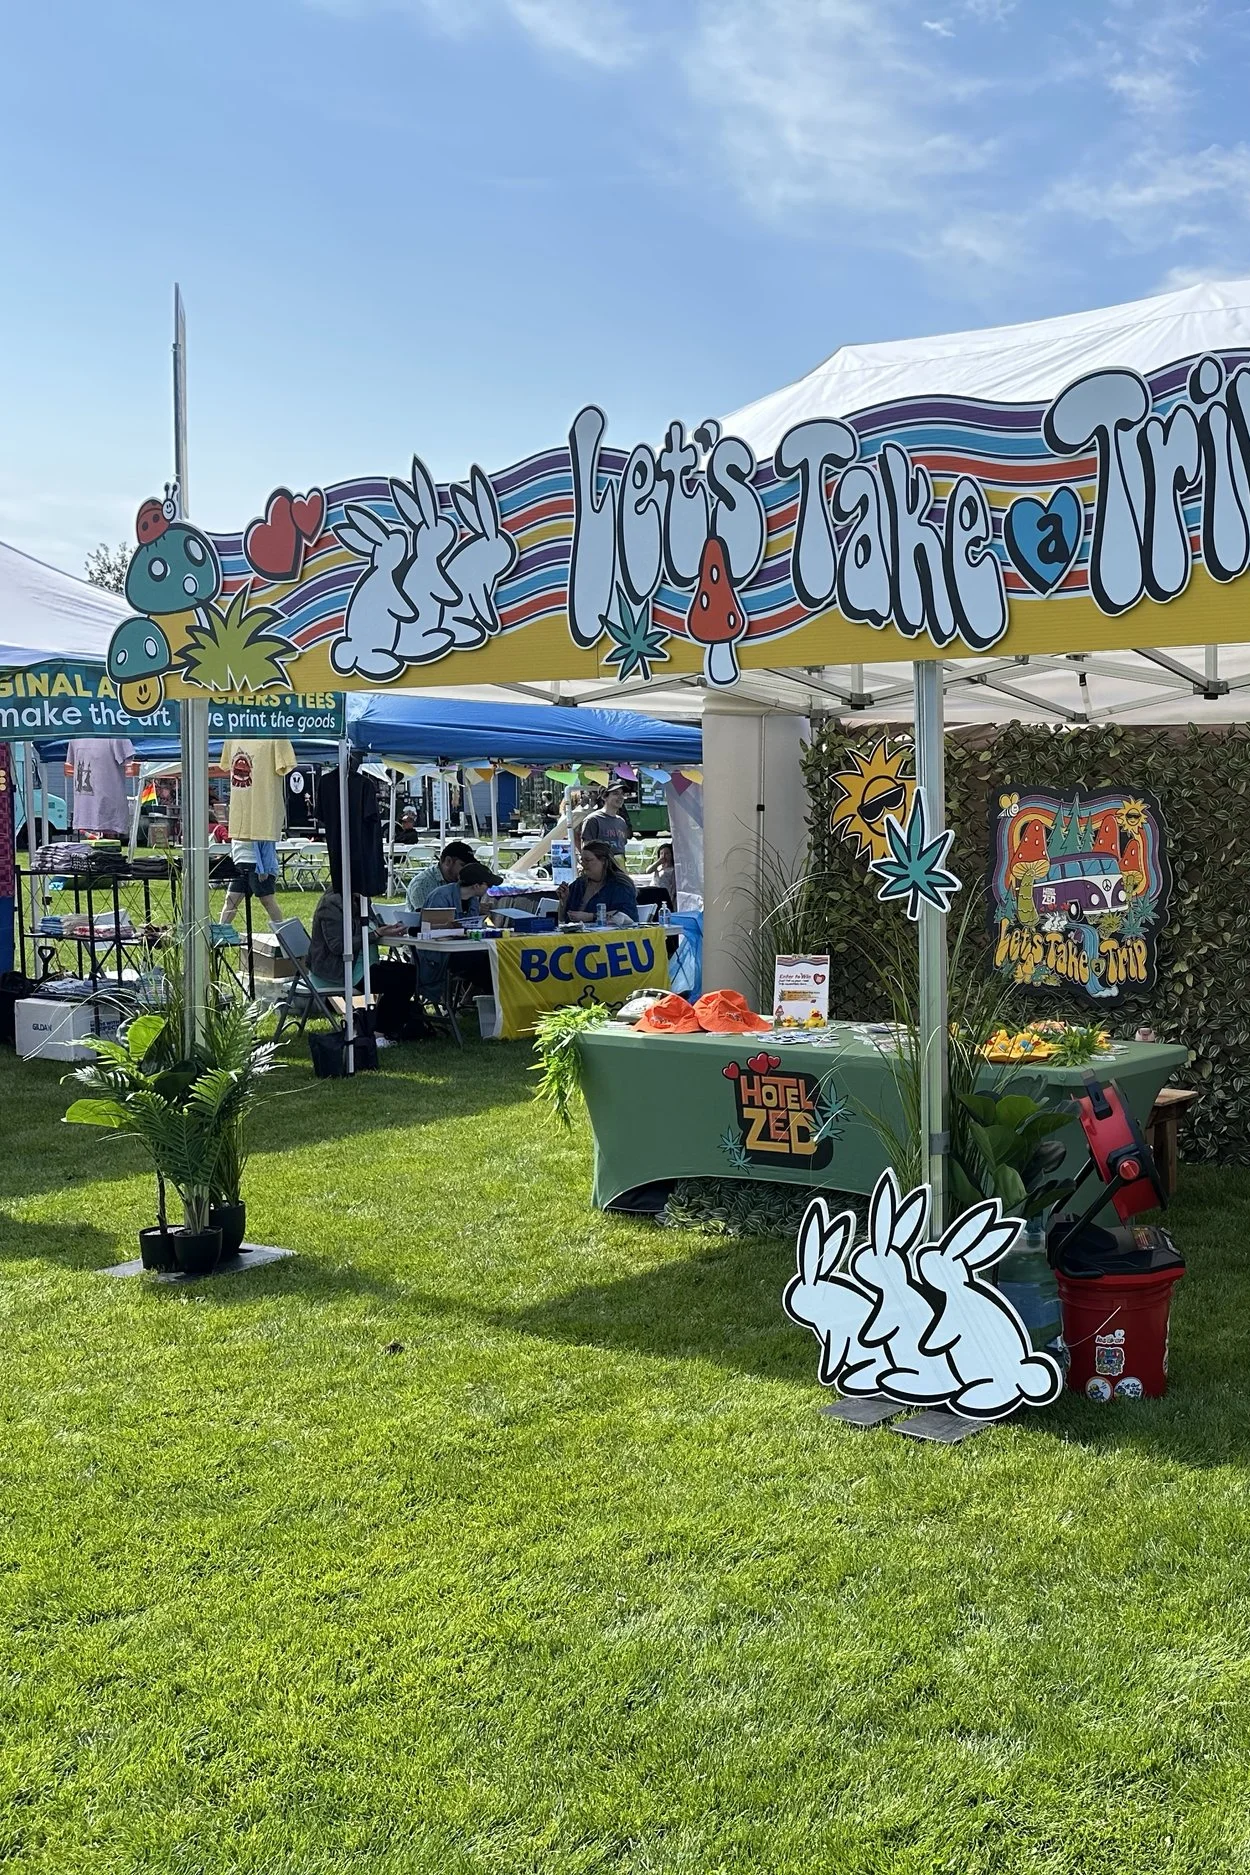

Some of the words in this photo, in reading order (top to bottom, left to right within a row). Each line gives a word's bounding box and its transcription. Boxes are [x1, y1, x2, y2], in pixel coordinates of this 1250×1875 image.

[569, 404, 767, 649] Let's
[774, 417, 1009, 651] Take
[1036, 512, 1070, 565] a
[89, 703, 131, 725] the
[295, 692, 336, 709] TEES
[228, 709, 267, 732] print
[270, 711, 294, 728] the
[297, 713, 336, 733] goods
[520, 938, 655, 983] BCGEU
[1045, 931, 1090, 986] Take
[1099, 938, 1149, 986] Trip
[740, 1075, 814, 1110] HOTEL
[743, 1107, 818, 1155] ZED
